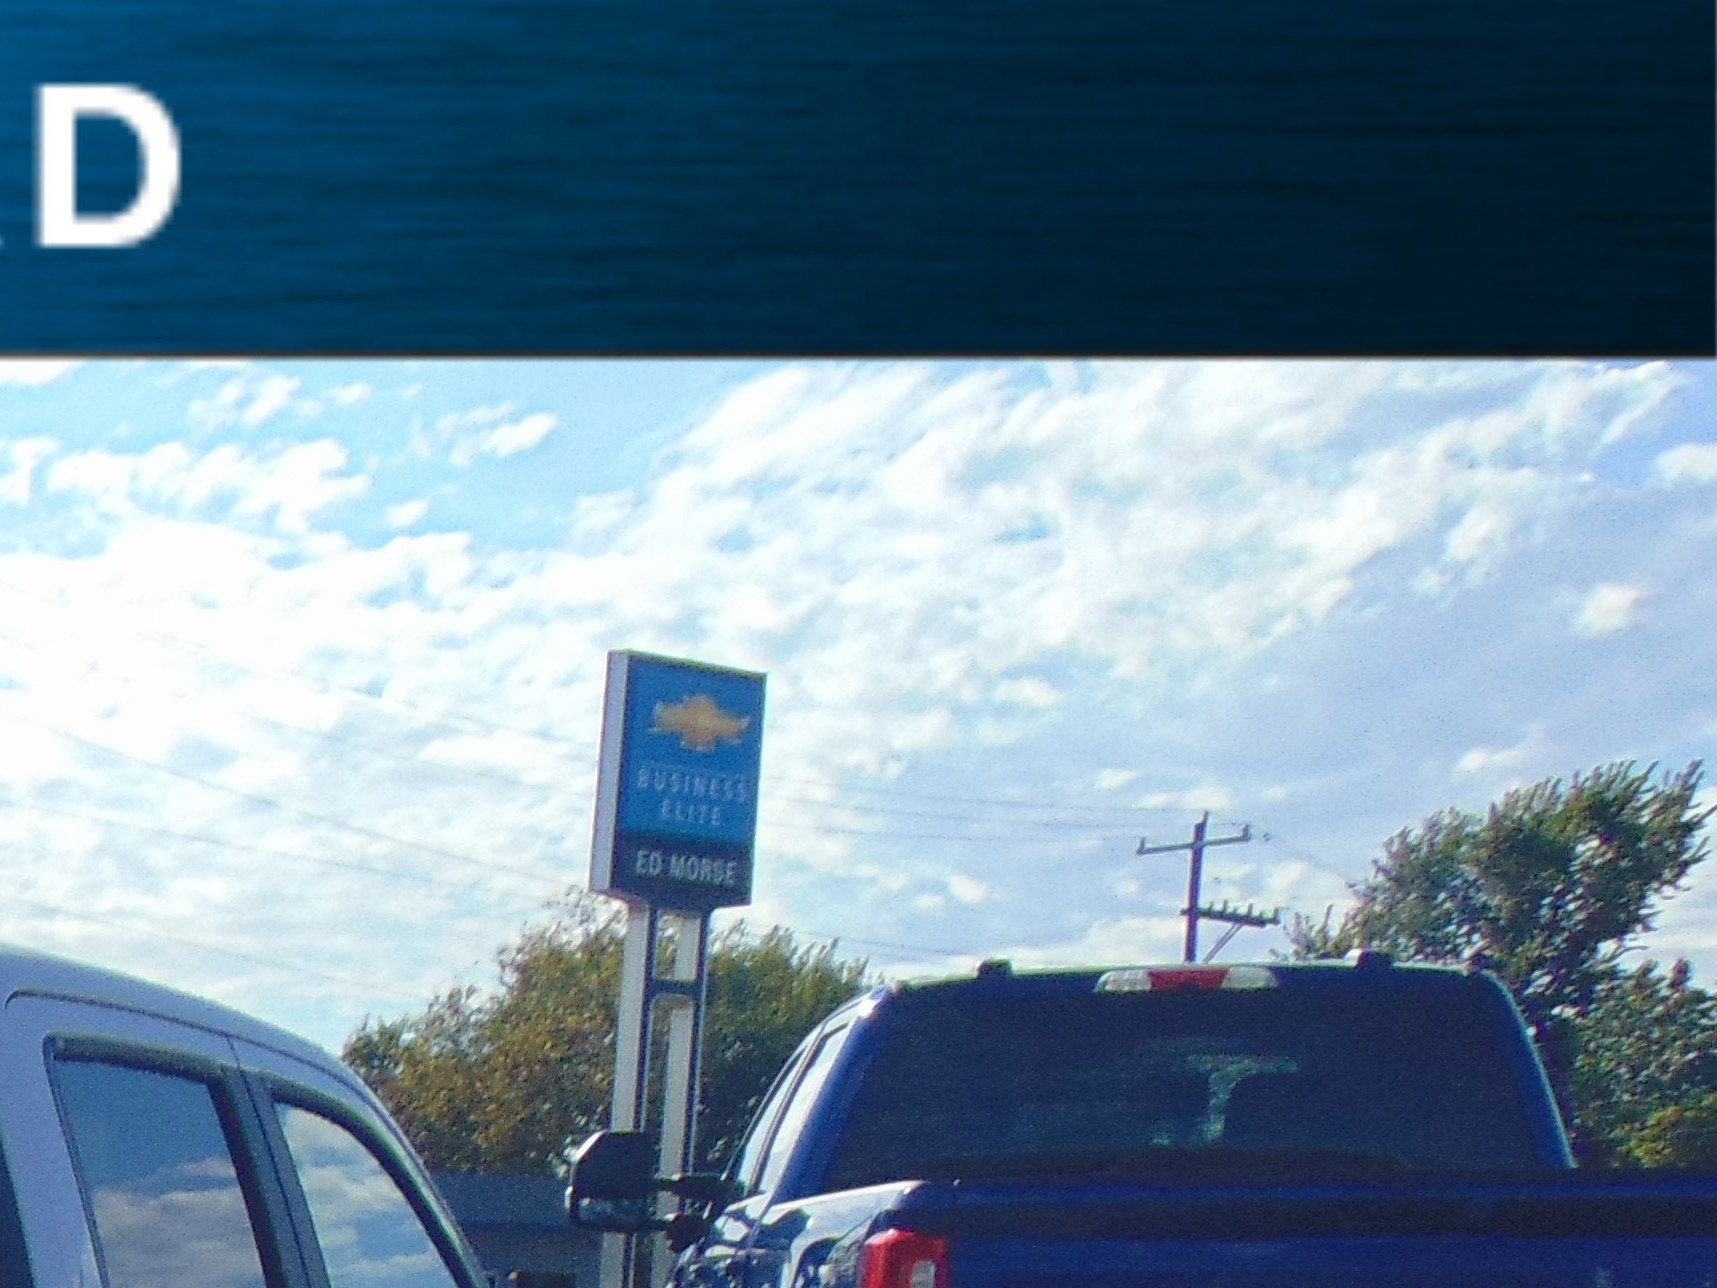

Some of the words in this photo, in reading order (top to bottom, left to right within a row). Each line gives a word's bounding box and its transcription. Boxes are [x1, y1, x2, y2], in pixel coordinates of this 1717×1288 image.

[638, 768, 748, 802] BUSINESS
[661, 800, 723, 826] ELITE
[635, 850, 663, 876] ED
[669, 854, 738, 886] MORSE
